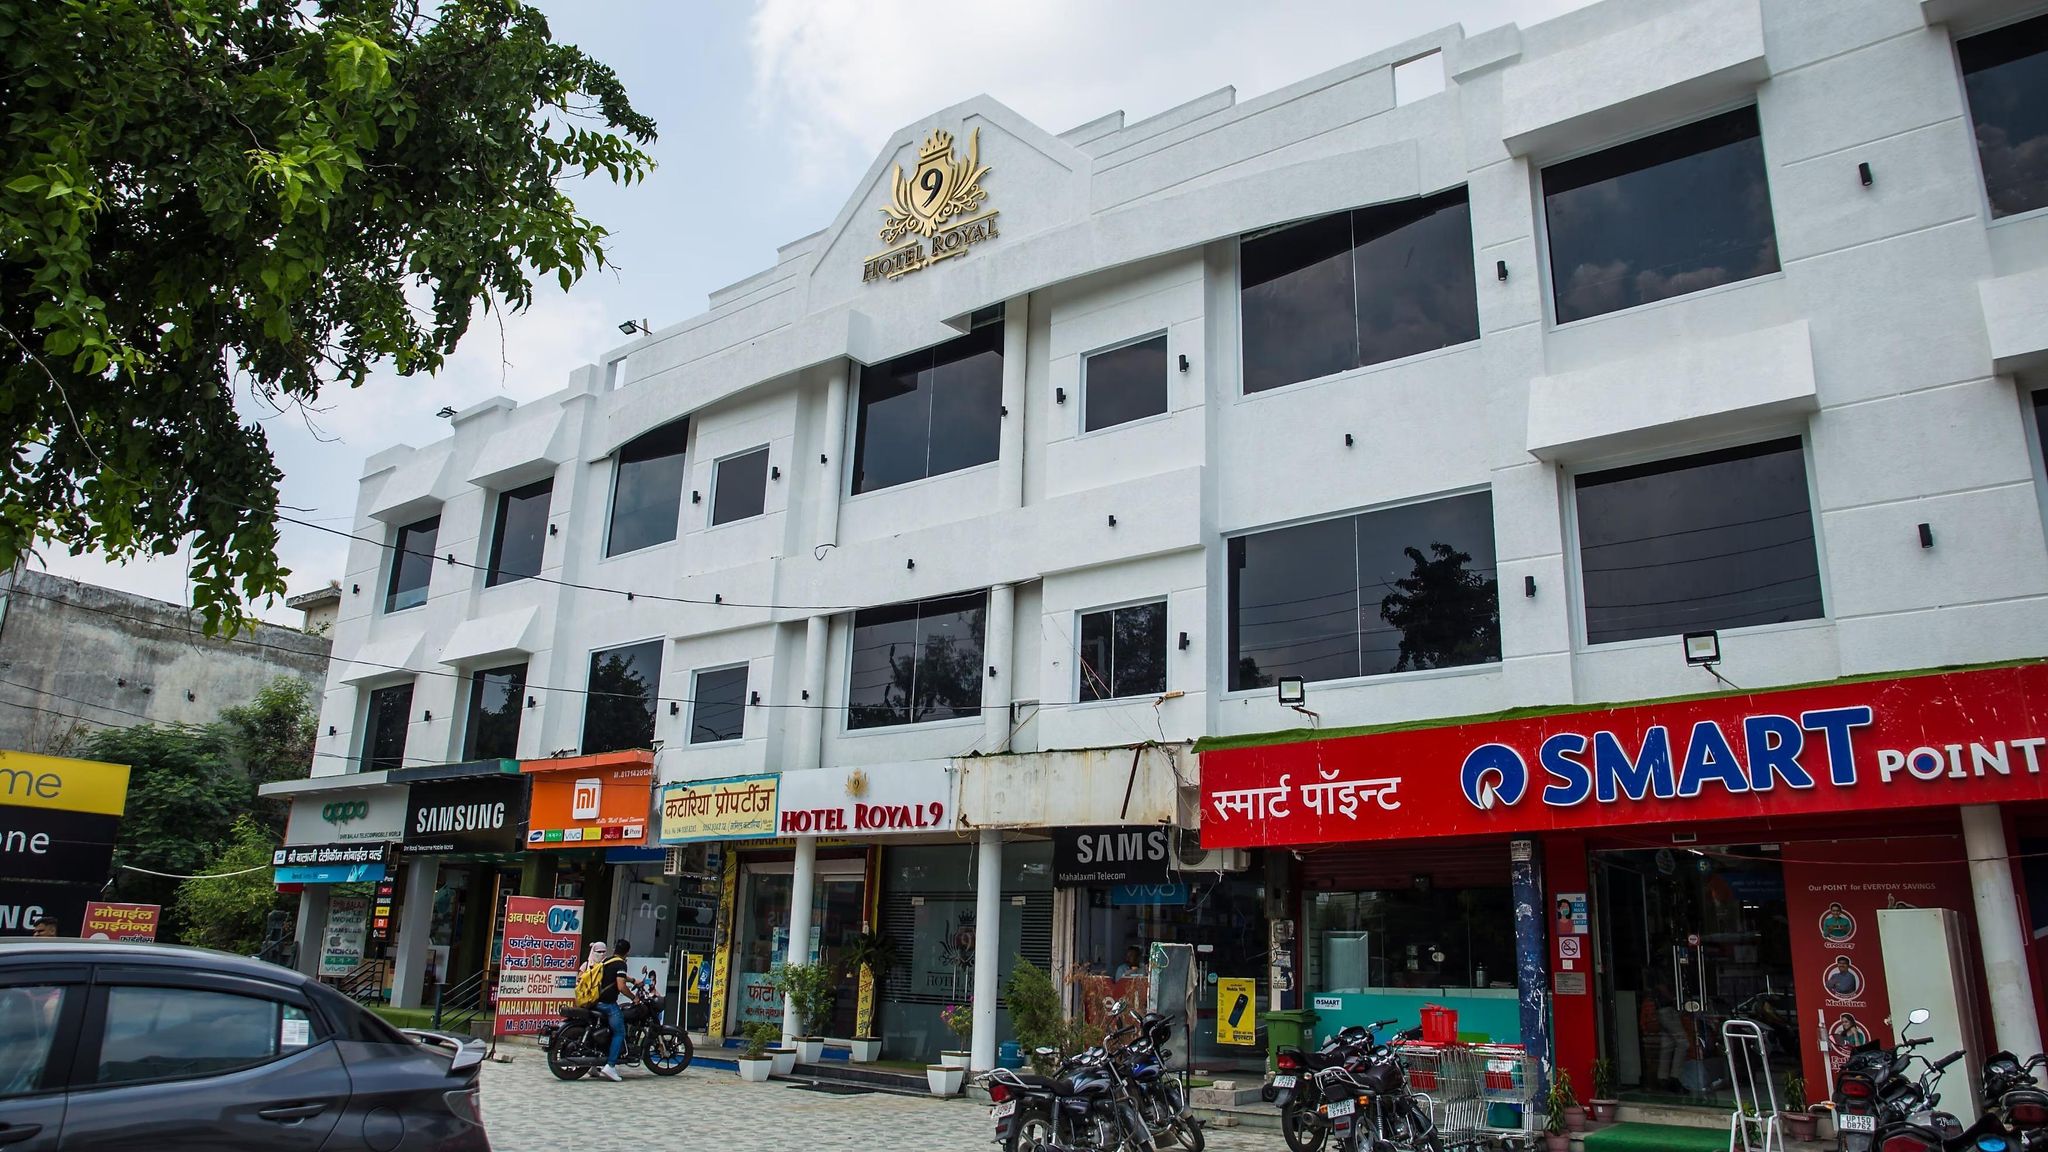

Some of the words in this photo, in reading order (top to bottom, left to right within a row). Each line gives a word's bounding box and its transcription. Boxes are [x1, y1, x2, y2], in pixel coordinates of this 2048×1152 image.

[920, 168, 944, 208] 9
[862, 244, 926, 283] HOTEL
[930, 215, 1000, 256] ROYAL
[1539, 705, 1873, 806] SMART
[1877, 737, 2047, 783] POINT
[665, 787, 712, 819] कटारिया
[714, 785, 776, 817] प्रोपर्टीज
[1211, 774, 1291, 821] स्मार्ट
[1300, 769, 1402, 821] पॉइन्ट
[416, 802, 505, 834] SAMSUNG
[780, 808, 847, 832] HOTEL
[0, 830, 49, 854] ne
[1059, 872, 1096, 881] Mahalaxmi
[1097, 872, 1126, 880] Telecom
[1863, 883, 1901, 891] EVERYDAY
[94, 906, 154, 920] मोबाईल
[508, 912, 523, 923] अब
[548, 907, 580, 933] 0%
[89, 919, 154, 933] फाईनेन्स
[543, 940, 555, 949] पर
[556, 938, 574, 950] फोन
[505, 955, 529, 967] केवल
[530, 955, 541, 967] 15
[500, 974, 527, 984] SAMSUNG
[528, 973, 552, 984] HOME
[527, 984, 554, 994] CREDIT
[499, 1001, 543, 1015] MAHALAXMI
[1825, 999, 1867, 1008] Medicines
